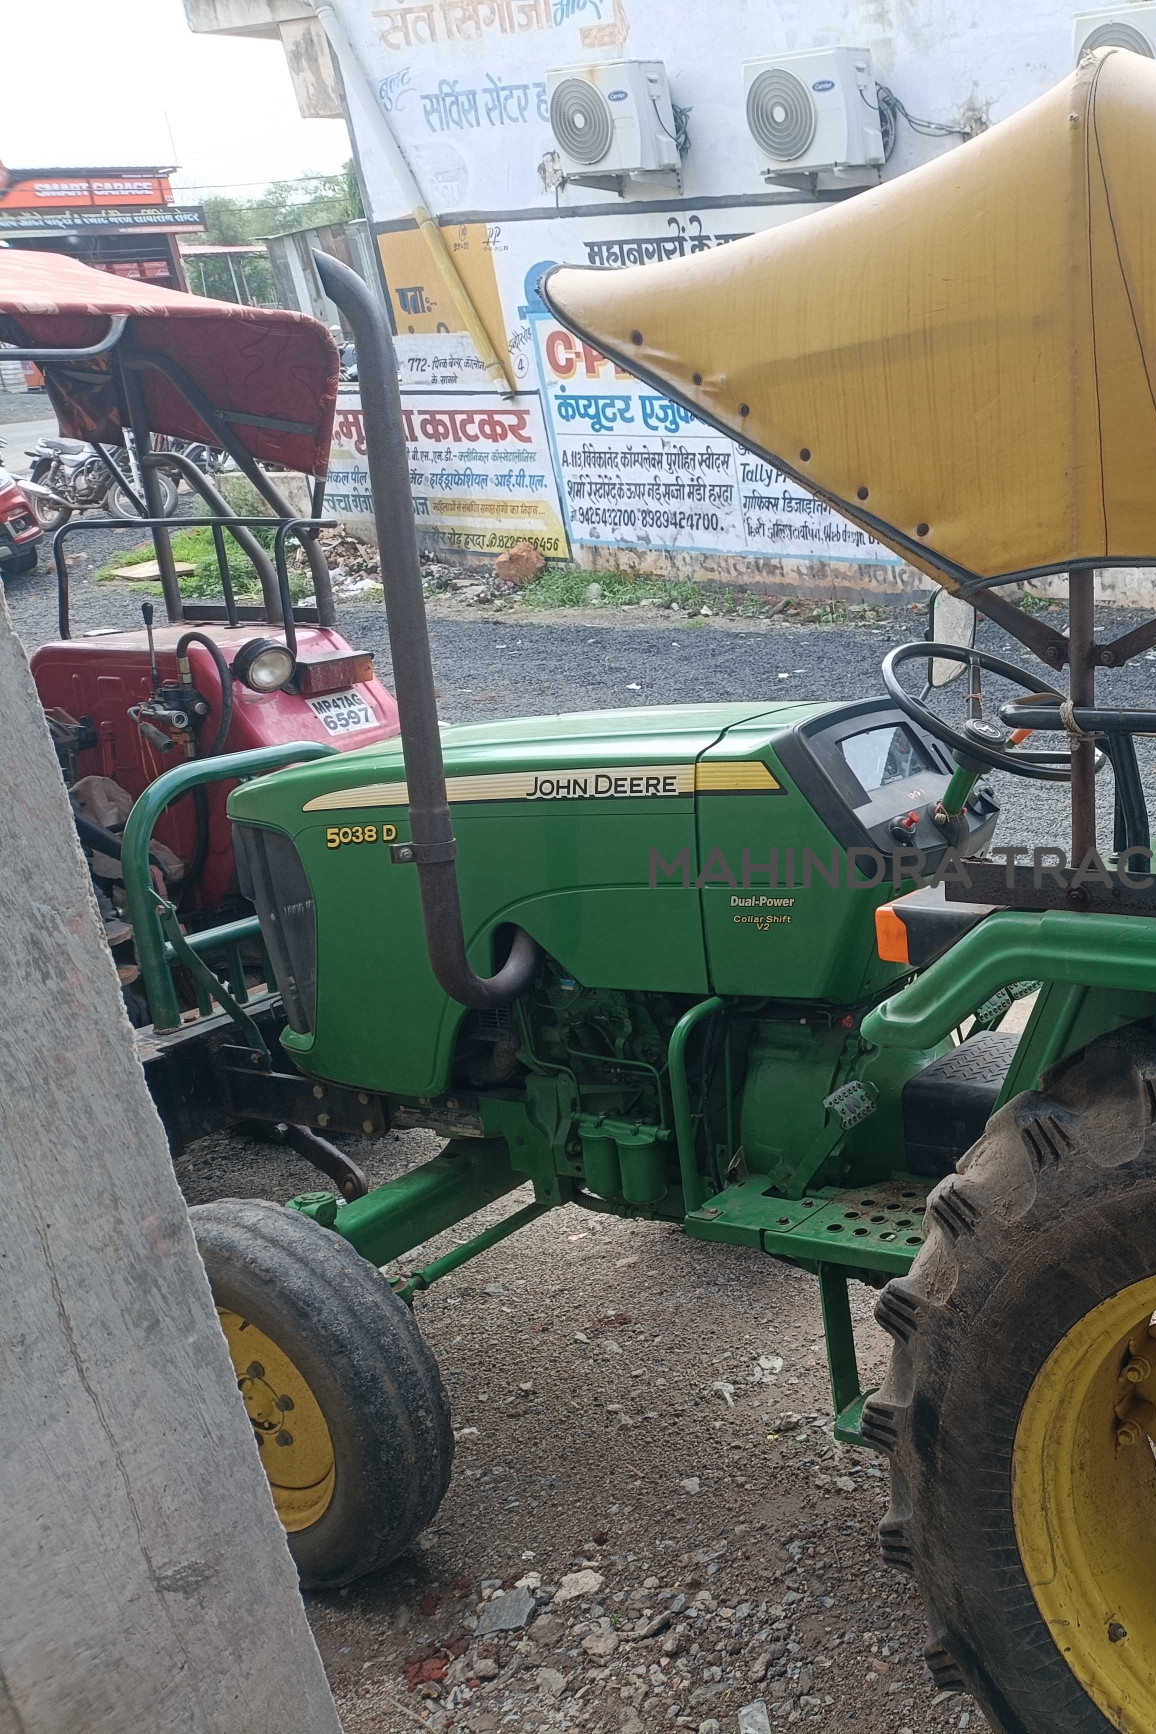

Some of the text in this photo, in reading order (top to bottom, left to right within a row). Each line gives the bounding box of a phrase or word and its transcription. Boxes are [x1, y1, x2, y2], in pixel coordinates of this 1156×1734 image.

[420, 79, 482, 133] सर्विस
[481, 72, 530, 128] सेंटर
[33, 181, 154, 198] SMART GARAGE
[554, 384, 635, 434] कंप्यूटर
[417, 409, 533, 444] काटकर
[664, 444, 697, 477] पुरोहित
[350, 464, 368, 487] पील
[740, 463, 773, 487] Tally
[567, 474, 587, 503] शर्मा
[625, 482, 649, 507] ऊपर
[686, 475, 707, 503] मंडी
[708, 483, 734, 510] हरदा
[578, 506, 636, 528] 9425432700
[311, 693, 363, 715] MP47AG
[323, 707, 370, 731] 6597
[525, 774, 678, 798] JOHN DEERE
[326, 824, 397, 849] 5038 D
[730, 895, 795, 907] Dual-Power
[756, 923, 770, 931] V2
[766, 915, 792, 923] Shift
